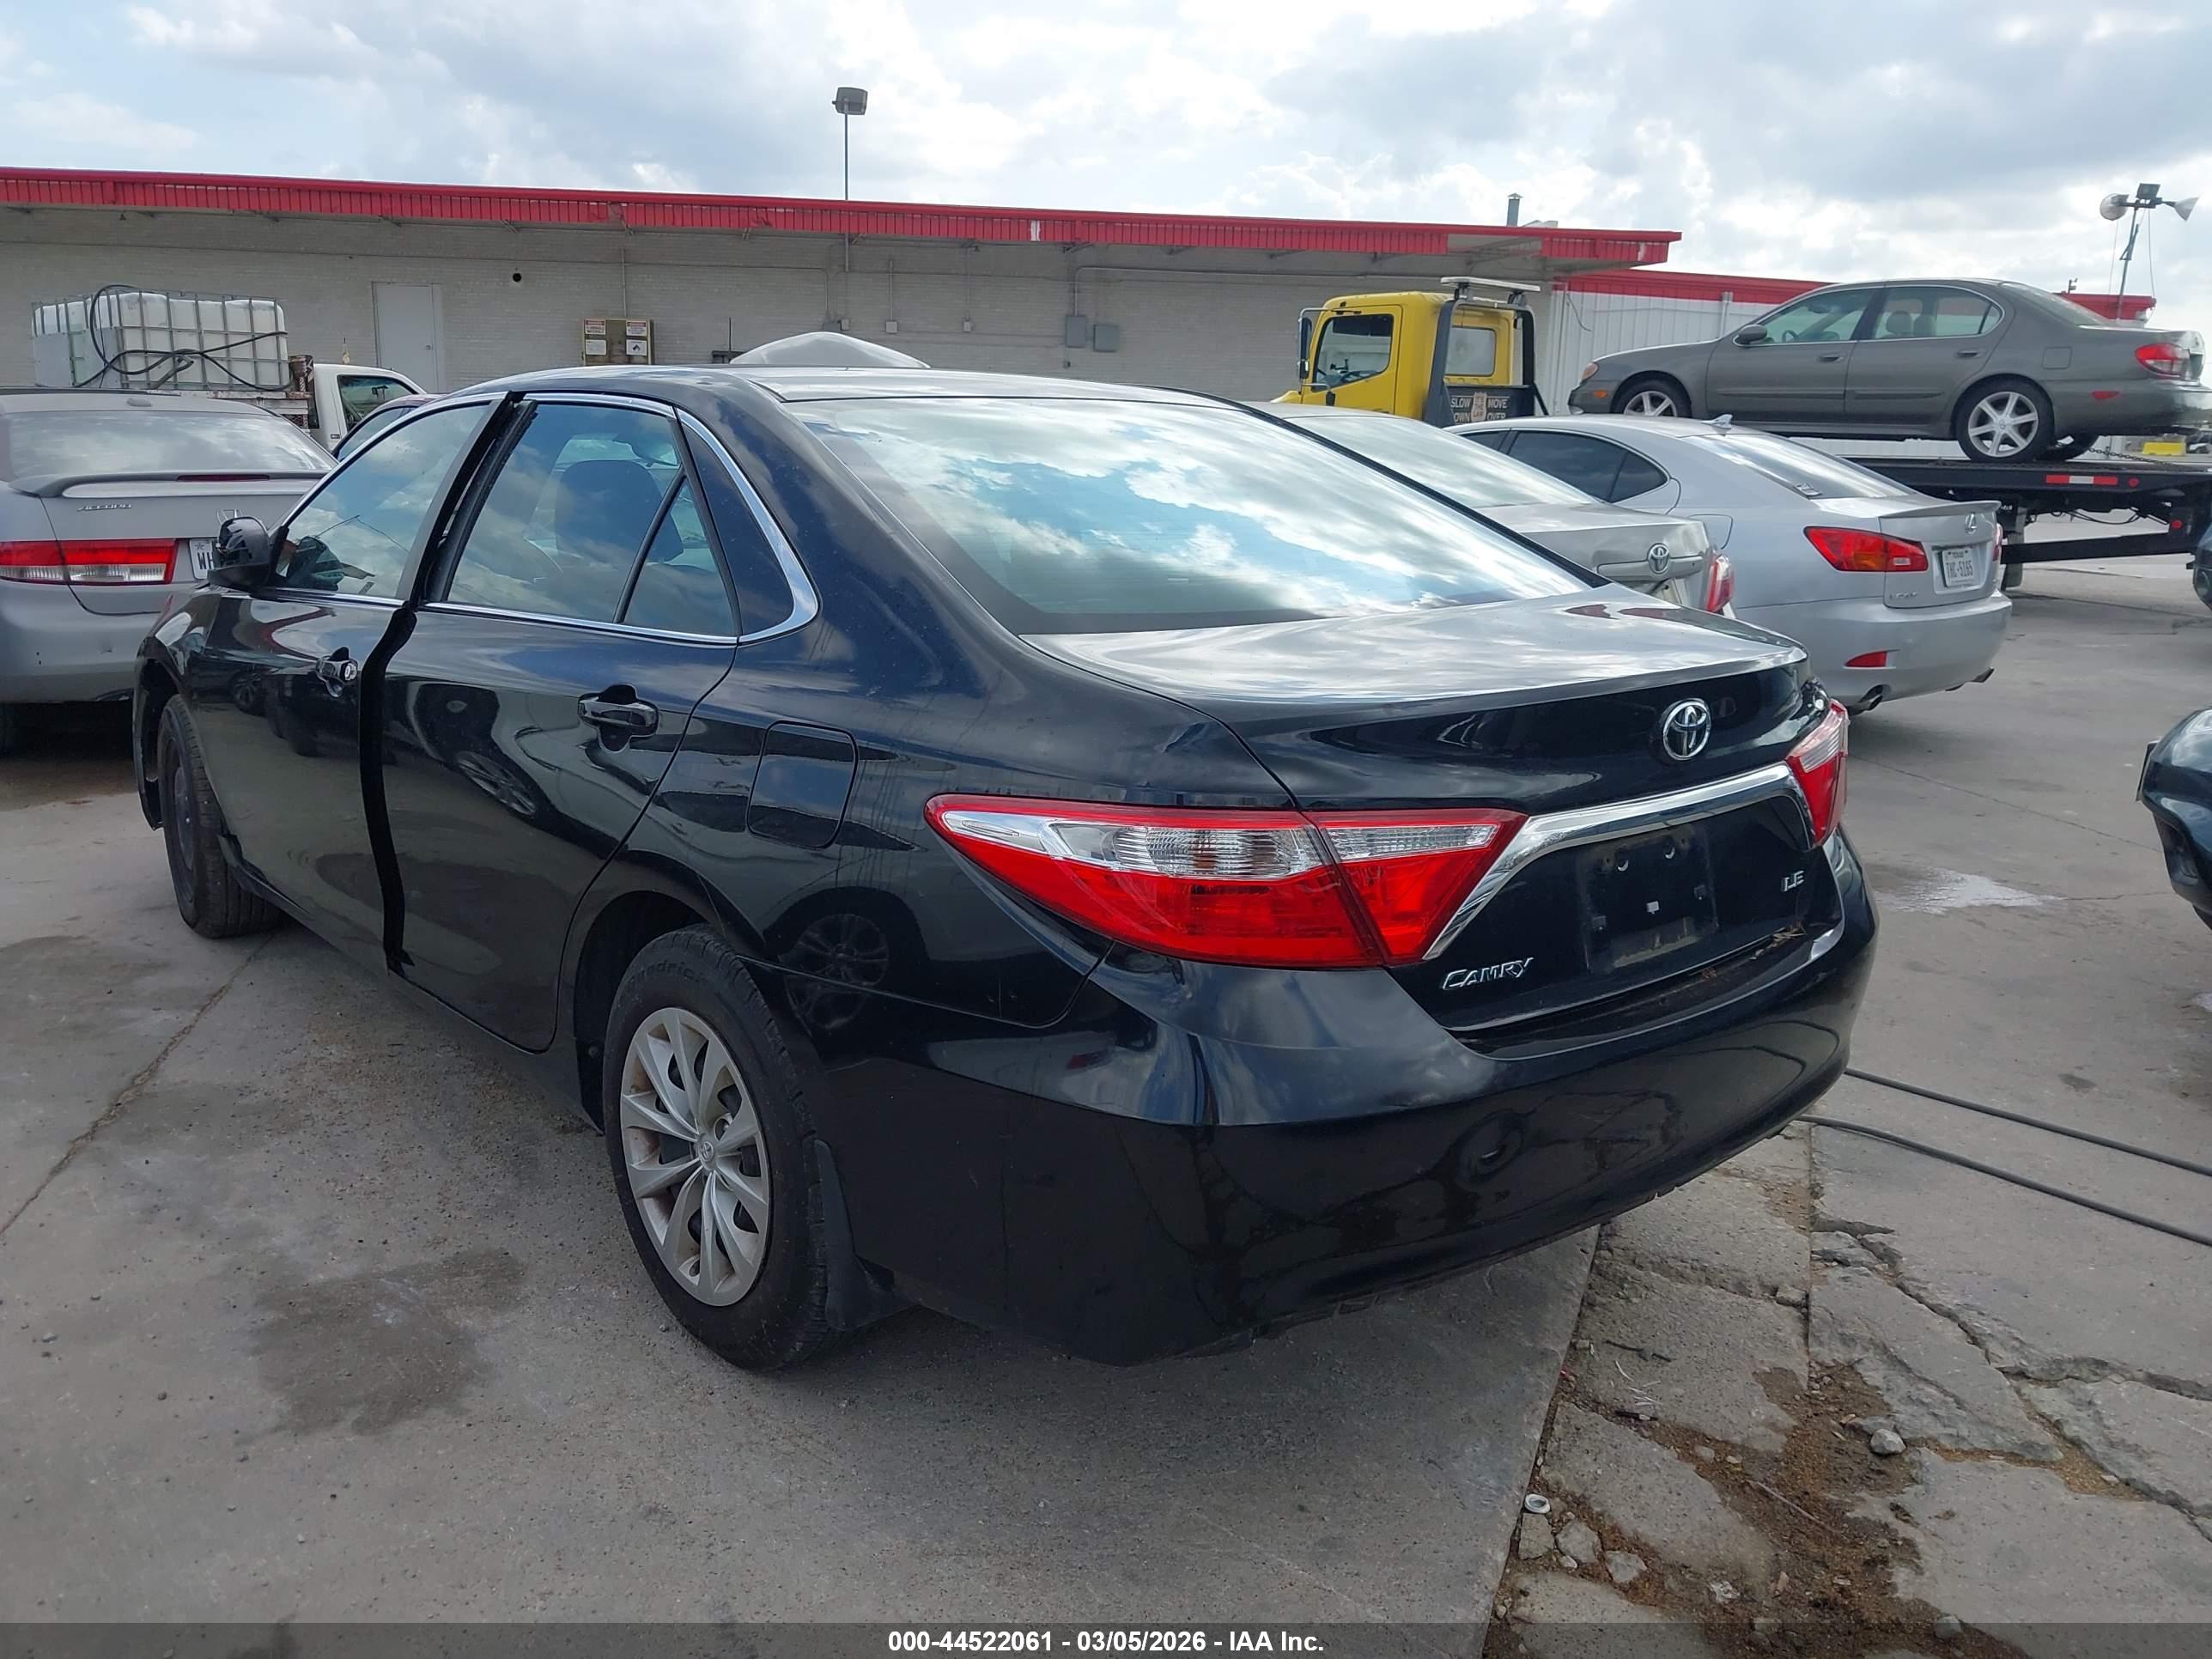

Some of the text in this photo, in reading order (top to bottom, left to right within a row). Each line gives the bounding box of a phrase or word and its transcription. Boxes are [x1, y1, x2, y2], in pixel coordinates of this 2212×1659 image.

[1450, 398, 1472, 408] SLOW
[1487, 398, 1508, 409] MOVE
[1454, 412, 1470, 422] OWN
[1781, 870, 1805, 892] LE
[1443, 957, 1534, 990] CAMRY
